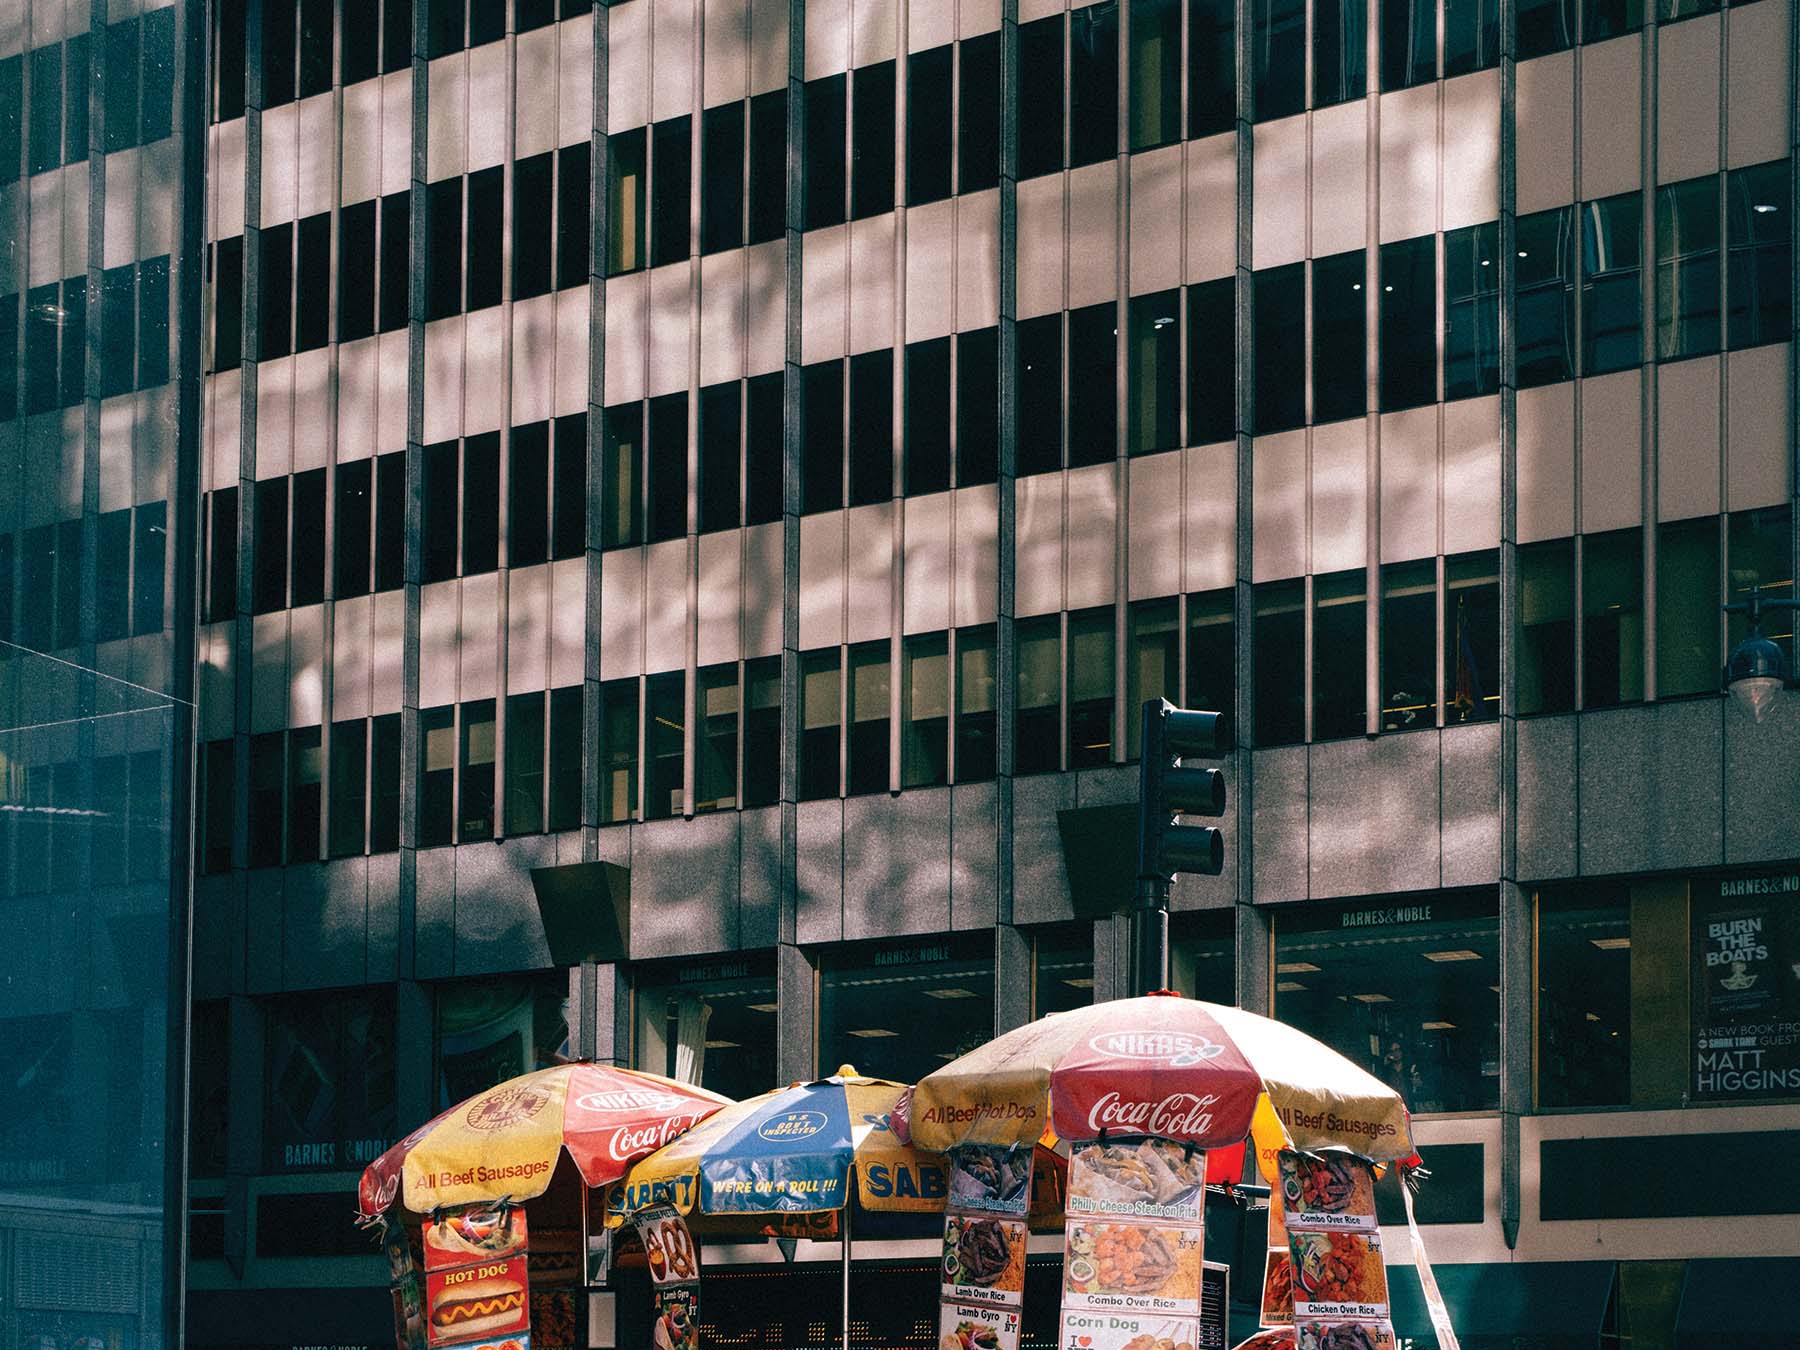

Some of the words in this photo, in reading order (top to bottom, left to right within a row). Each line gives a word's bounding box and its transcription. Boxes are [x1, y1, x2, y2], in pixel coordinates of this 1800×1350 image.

[1708, 918, 1762, 939] BURN
[1717, 933, 1756, 949] THE
[1705, 945, 1768, 967] BOATS
[1708, 1025, 1739, 1038] NEW
[1741, 1022, 1775, 1036] BOOK
[1108, 1032, 1195, 1052] NIKAS
[1760, 1034, 1799, 1047] GUEST
[1698, 1050, 1766, 1073] MATT
[1698, 1068, 1800, 1092] HIGGINS
[921, 1105, 944, 1124] All
[946, 1102, 980, 1122] Beef
[981, 1102, 1006, 1121] Hot
[1088, 1091, 1221, 1135] Coca-Cola
[1293, 1109, 1325, 1130] Beef
[1326, 1113, 1397, 1140] Sausages
[414, 1172, 438, 1190] All
[438, 1167, 476, 1188] Beef
[477, 1158, 550, 1186] Sausages
[754, 1180, 774, 1193] ON
[775, 1180, 787, 1193] A
[789, 1179, 820, 1193] ROLL
[1070, 1196, 1098, 1212] Philly
[1099, 1197, 1134, 1213] Cheese
[1134, 1200, 1163, 1215] Steak
[1164, 1206, 1177, 1216] on
[1177, 1203, 1197, 1218] Pita
[1300, 1213, 1326, 1225] Combo
[1326, 1214, 1344, 1226] Over
[1345, 1215, 1361, 1225] Rice
[1178, 1240, 1198, 1250] NY
[445, 1266, 475, 1286] HOT
[477, 1262, 509, 1281] DOG
[663, 1289, 677, 1300] Lamb
[954, 1285, 972, 1299] Lamb
[973, 1288, 989, 1301] Over
[990, 1289, 1006, 1301] Rice
[1086, 1295, 1123, 1308] Combo
[1124, 1297, 1150, 1309] Over
[1152, 1297, 1177, 1309] Rice
[1307, 1303, 1340, 1315] Chicken
[1341, 1304, 1358, 1315] Over
[1359, 1304, 1375, 1315] Rice
[956, 1305, 977, 1320] Lamb
[977, 1306, 1000, 1322] Gyro
[1004, 1323, 1018, 1334] NY
[1066, 1314, 1105, 1330] Corn
[1108, 1316, 1140, 1333] Dog
[1069, 1335, 1078, 1348] I
